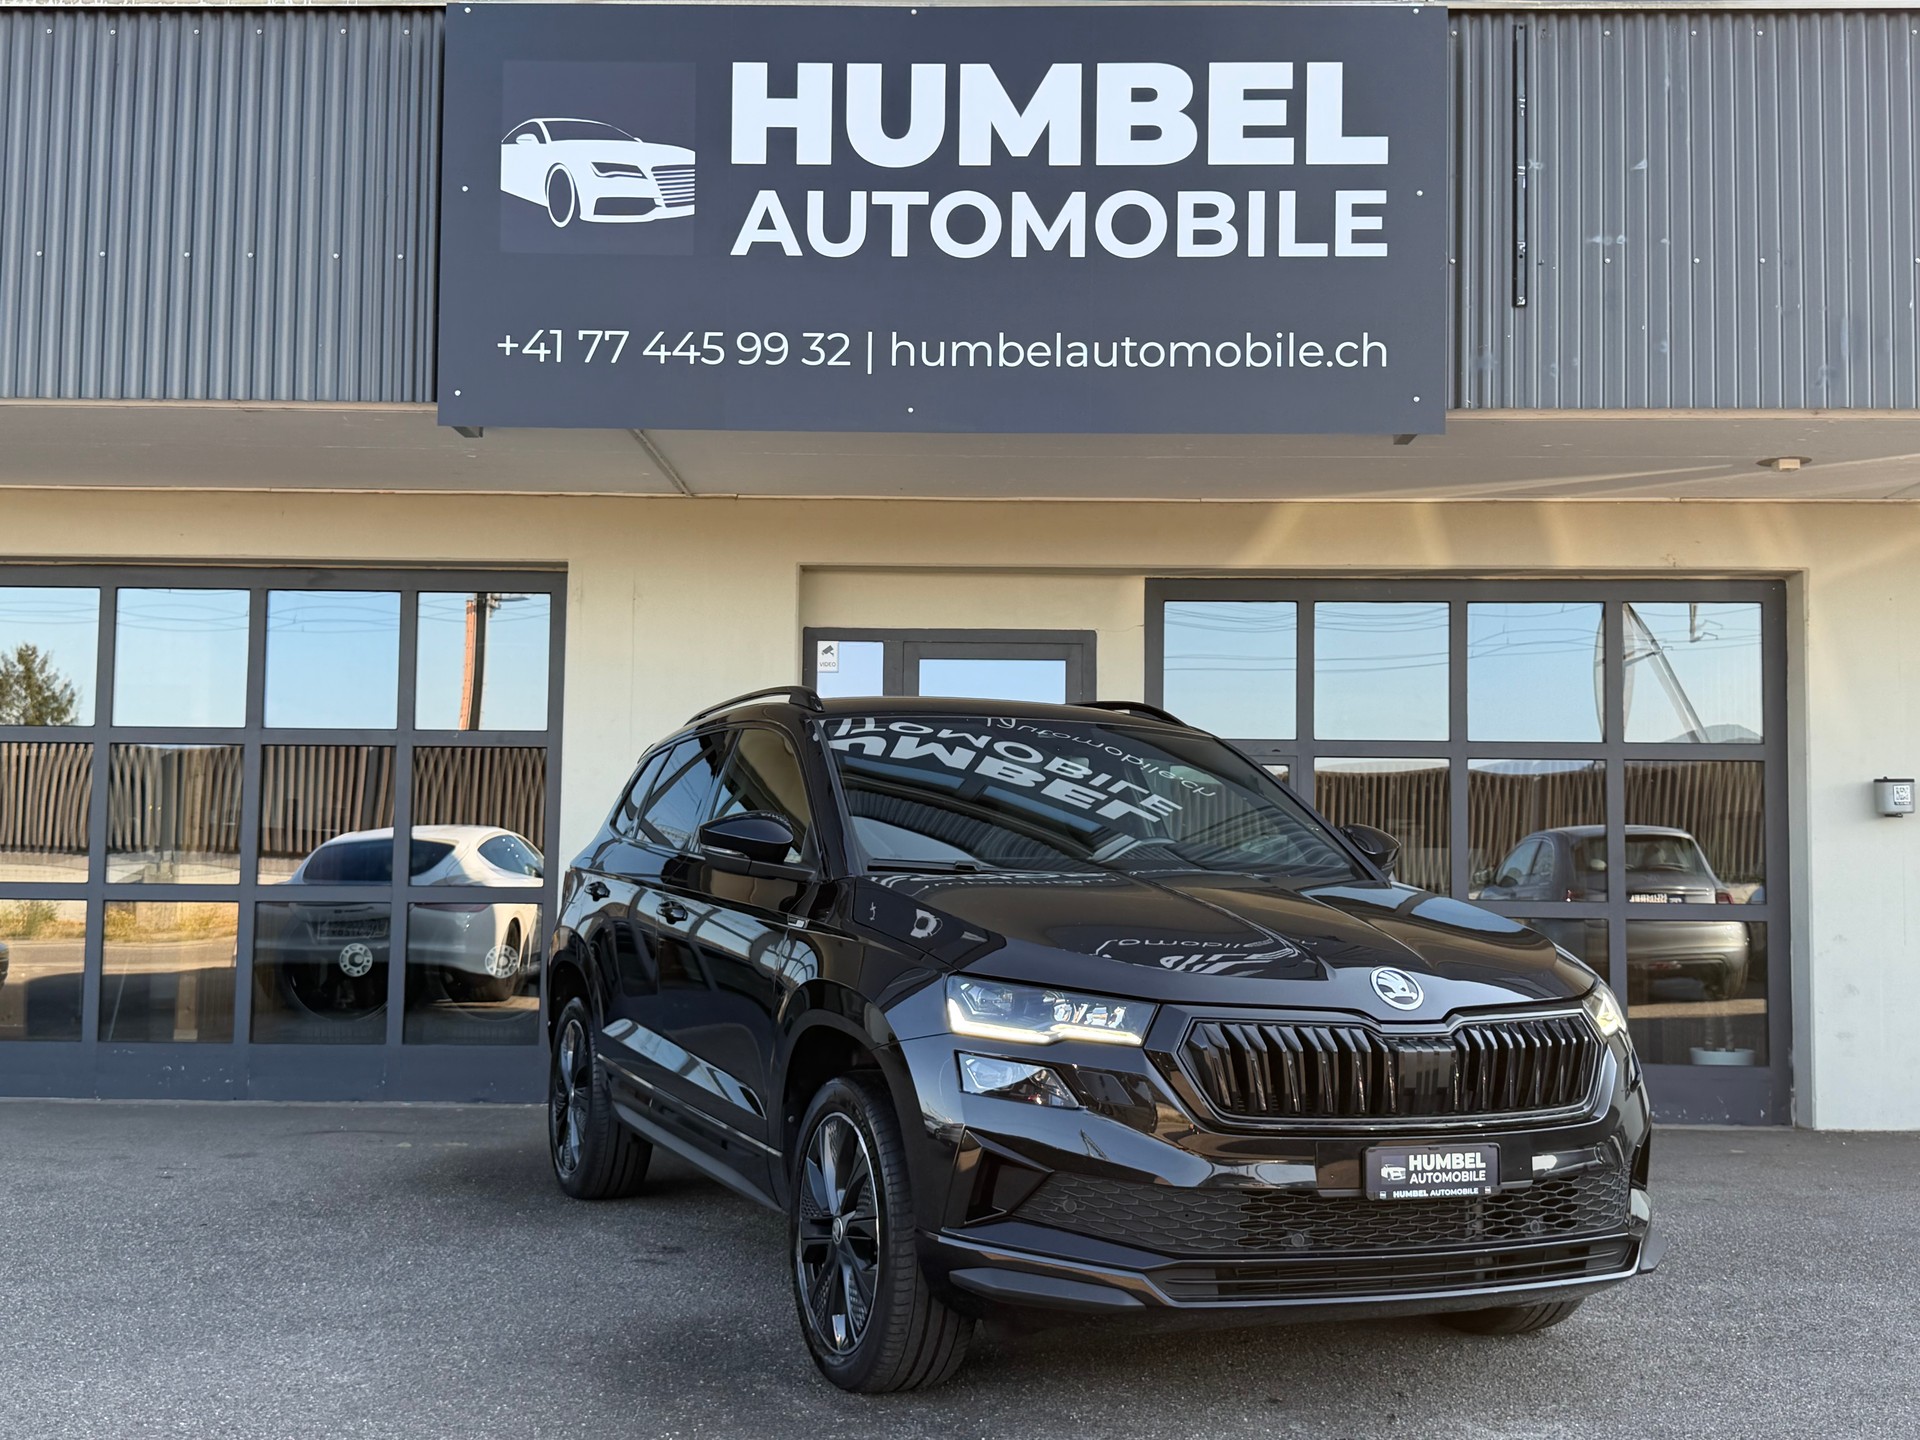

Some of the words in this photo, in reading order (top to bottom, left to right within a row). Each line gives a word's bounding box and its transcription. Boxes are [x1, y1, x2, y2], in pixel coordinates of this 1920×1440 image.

[730, 61, 1389, 168] HUMBEL
[730, 189, 1388, 259] AUTOMOBILE
[497, 329, 562, 363] +41
[577, 329, 630, 364] 77
[642, 330, 725, 365] 445
[736, 331, 789, 366] 99
[801, 332, 851, 366] 32
[891, 331, 1388, 368] humbelautomobile.ch
[1408, 1152, 1487, 1171] HUMBEL
[1409, 1170, 1487, 1185] AUTOMOBILE
[1393, 1189, 1429, 1199] HUMBEL
[1429, 1187, 1479, 1197] AUTOMOBILE
